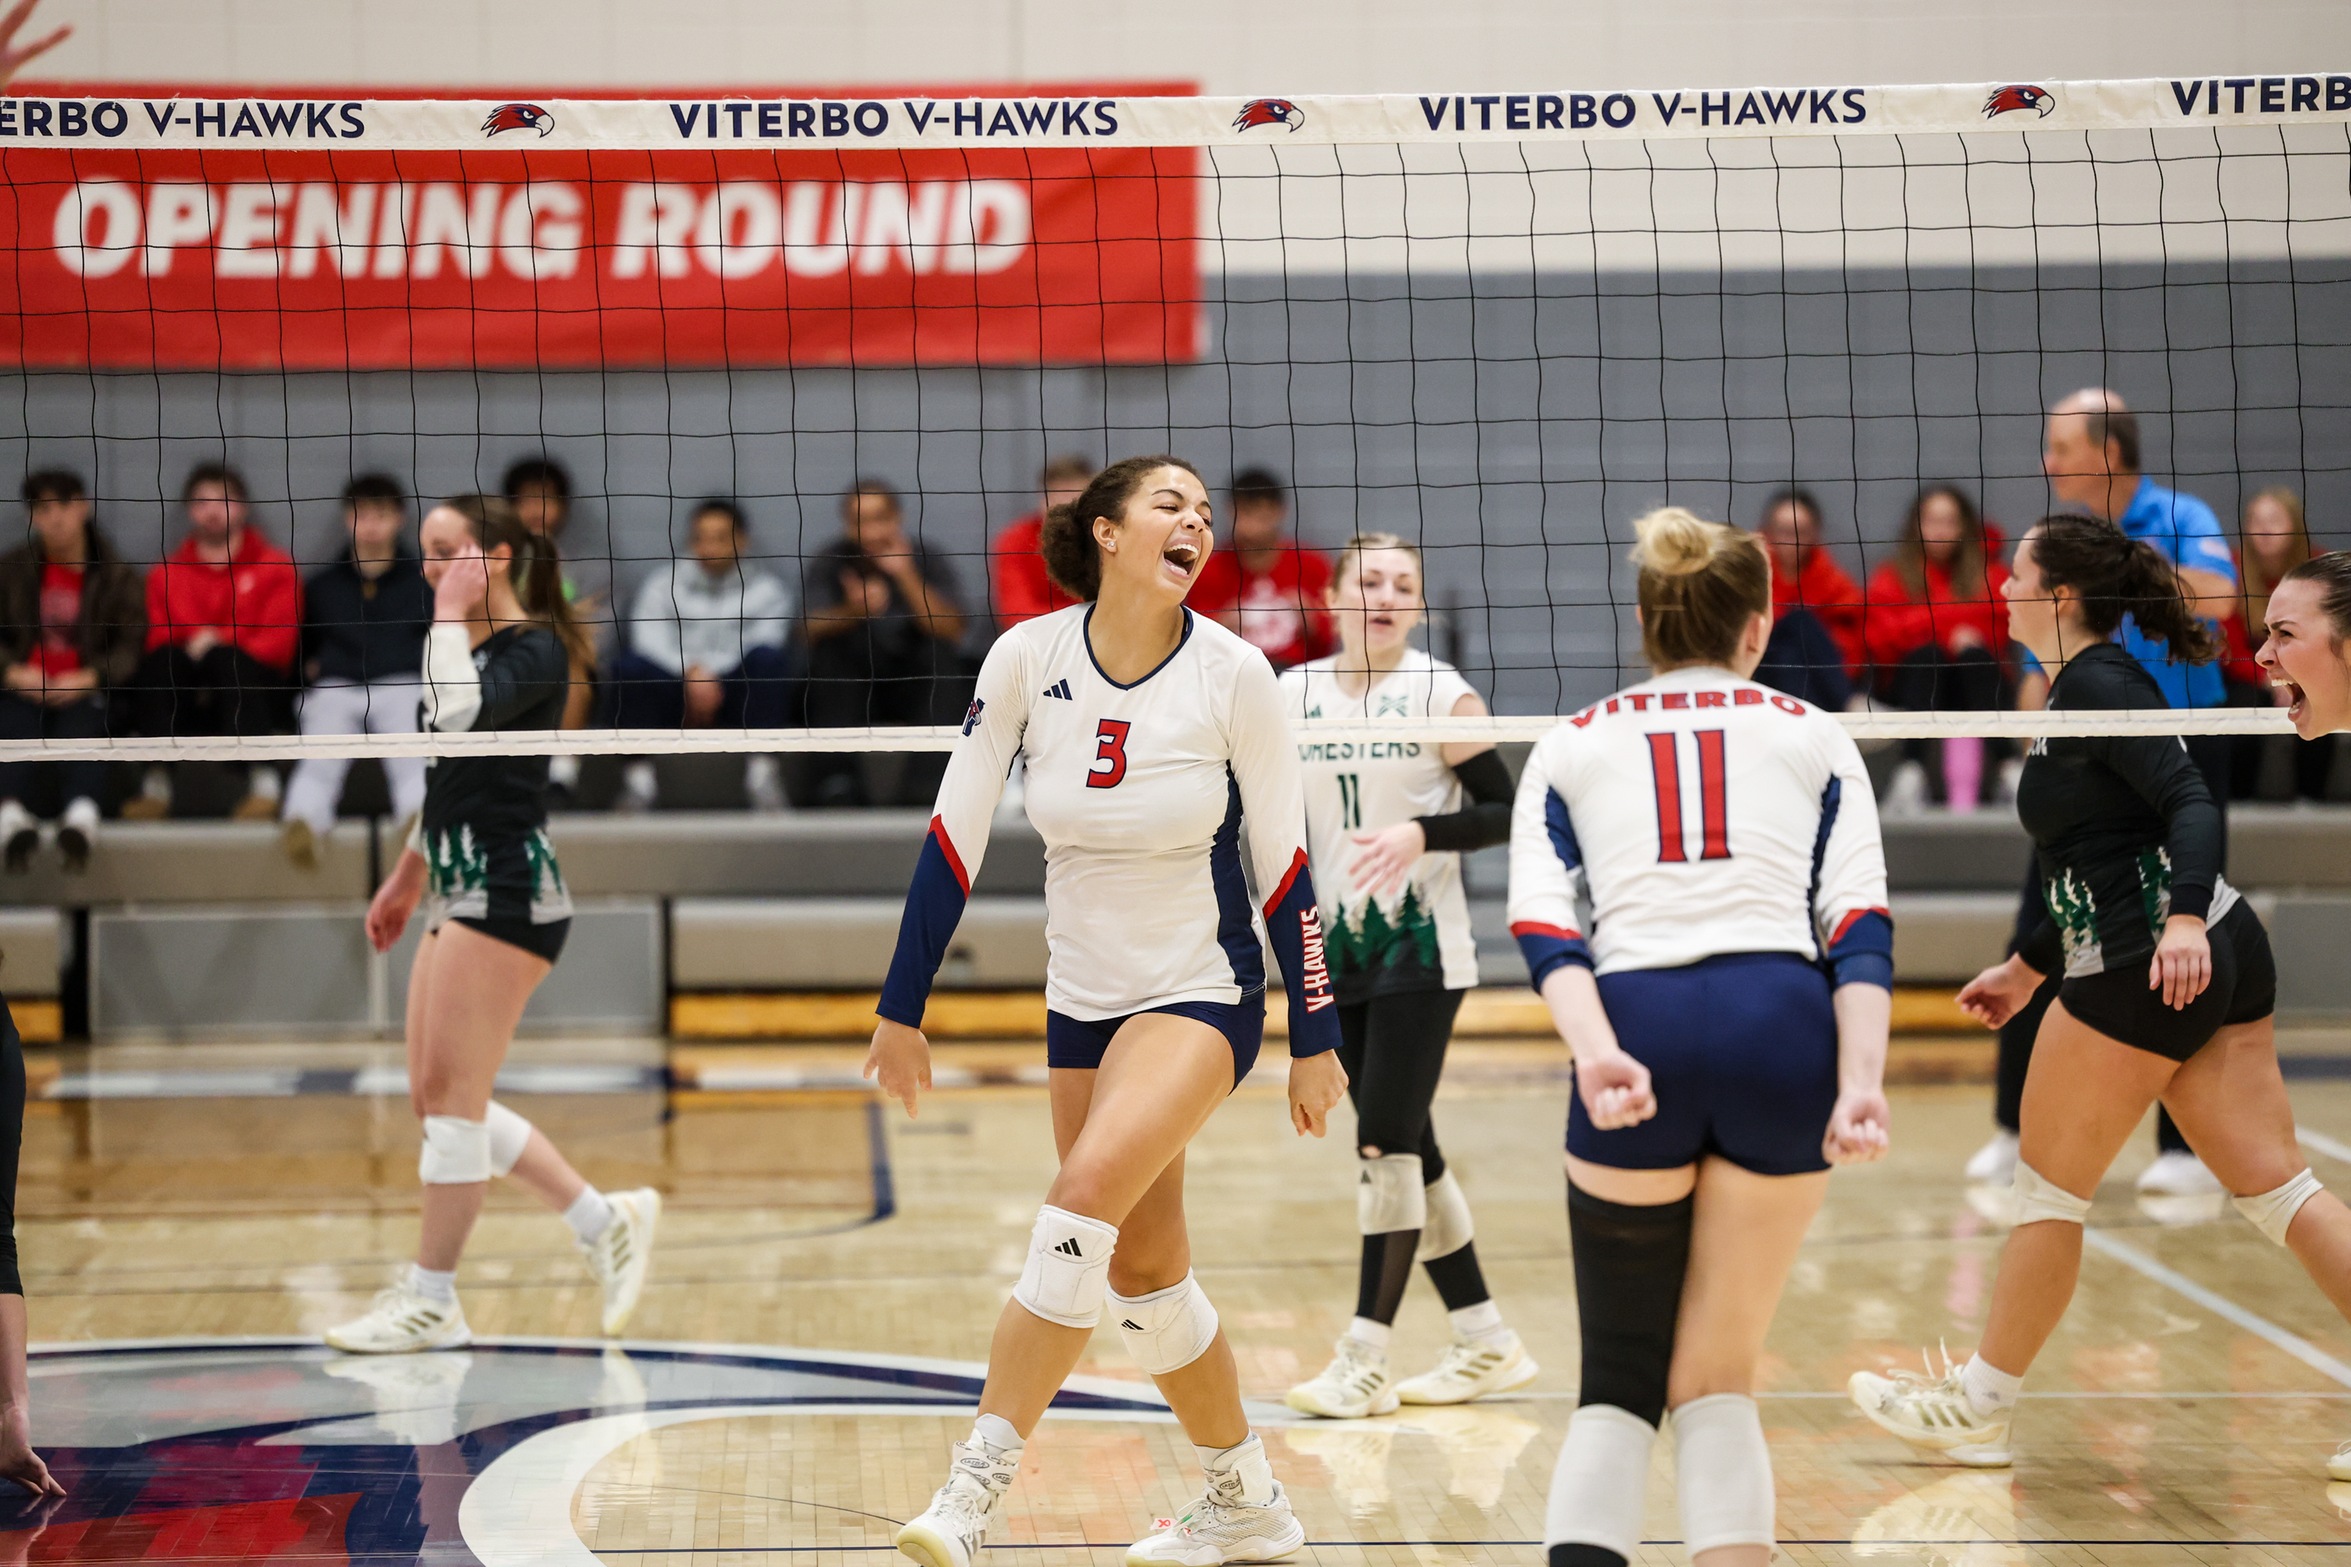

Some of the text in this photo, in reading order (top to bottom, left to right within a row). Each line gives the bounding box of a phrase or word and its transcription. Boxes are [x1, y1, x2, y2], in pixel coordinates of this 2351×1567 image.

[143, 102, 365, 139] V-HAWKS
[669, 101, 1118, 138] VITERBO V-HAWKS
[1418, 88, 1867, 131] VITERBO V-HAWKS
[53, 177, 1031, 279] OPENING ROUND
[1570, 689, 1806, 728] VITERBO
[1085, 718, 1131, 789] 3
[1337, 774, 1361, 830] 11
[1644, 729, 1733, 863] 11
[1299, 904, 1335, 1014] V-HAWKS
